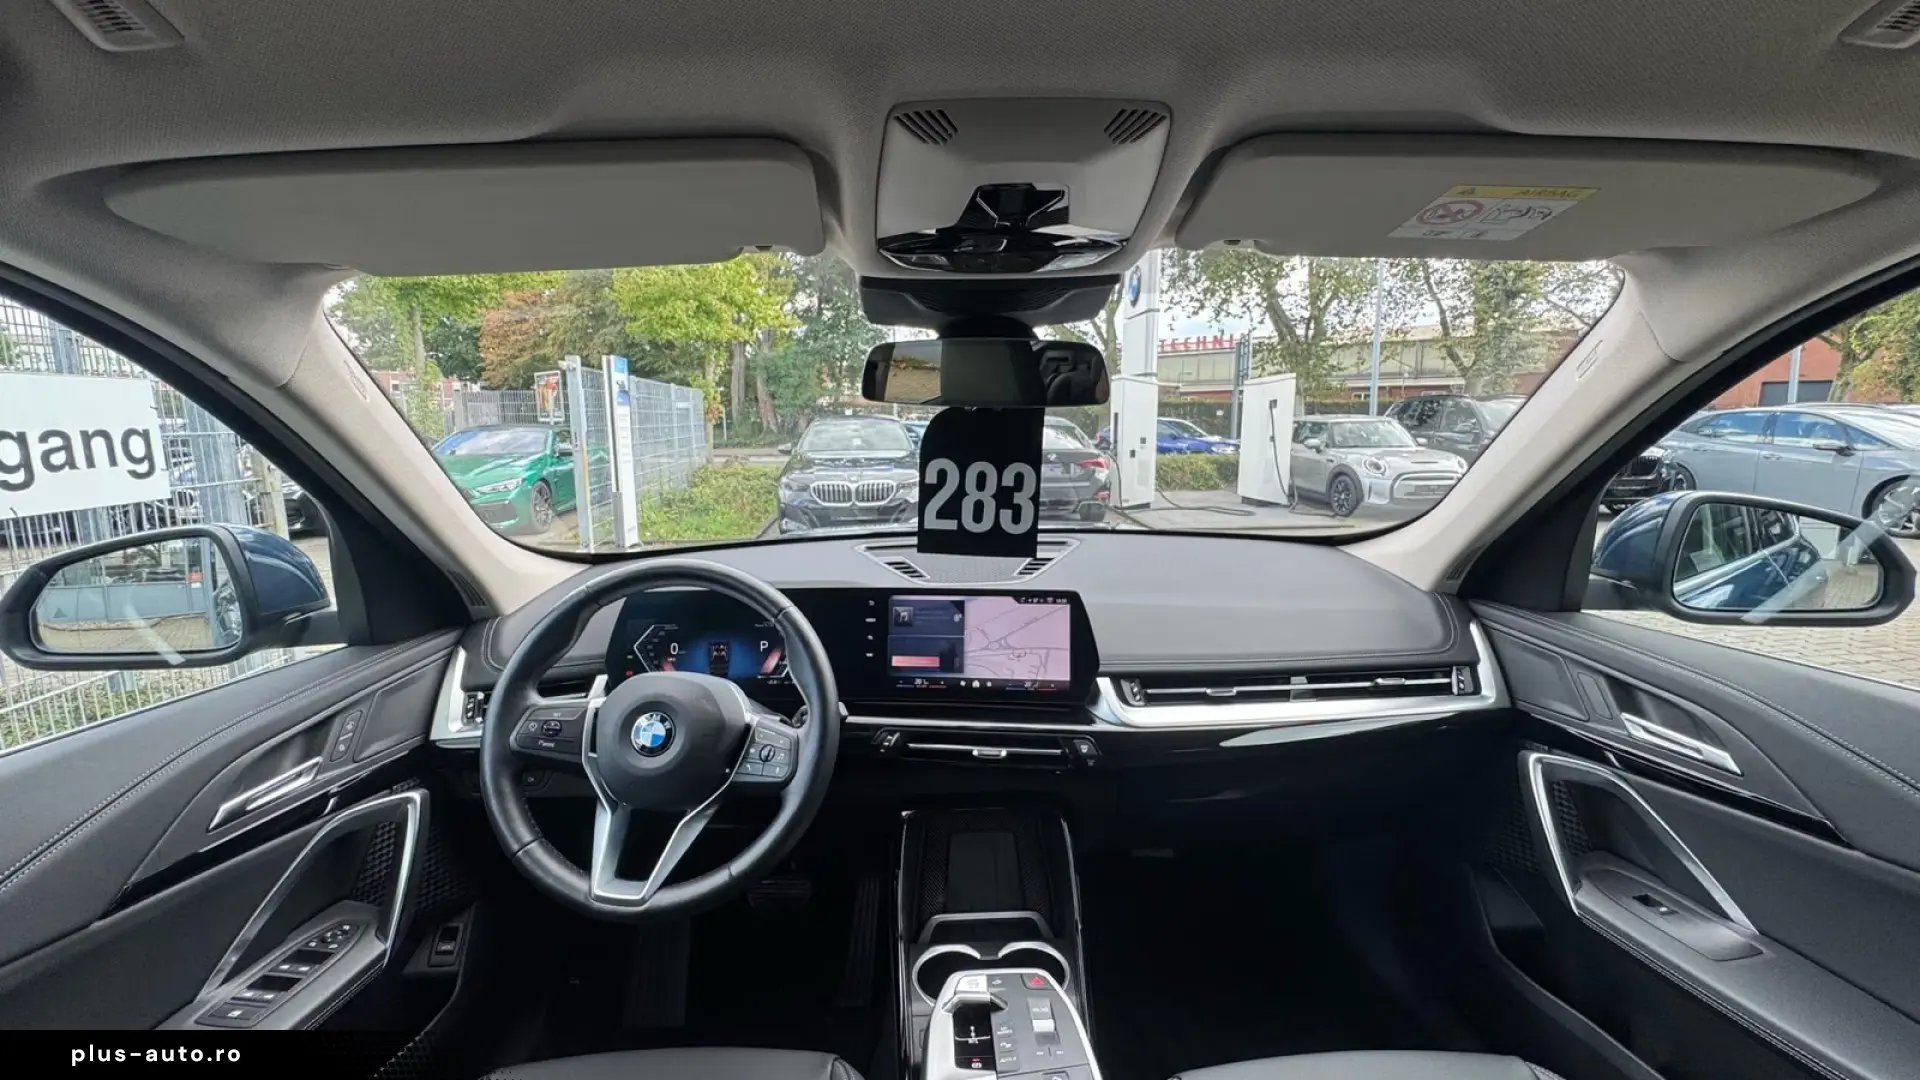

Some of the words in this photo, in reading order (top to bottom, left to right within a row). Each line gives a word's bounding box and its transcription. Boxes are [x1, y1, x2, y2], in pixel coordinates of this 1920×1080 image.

[0, 427, 156, 492] gang
[924, 457, 1037, 535] 283
[760, 640, 769, 652] P
